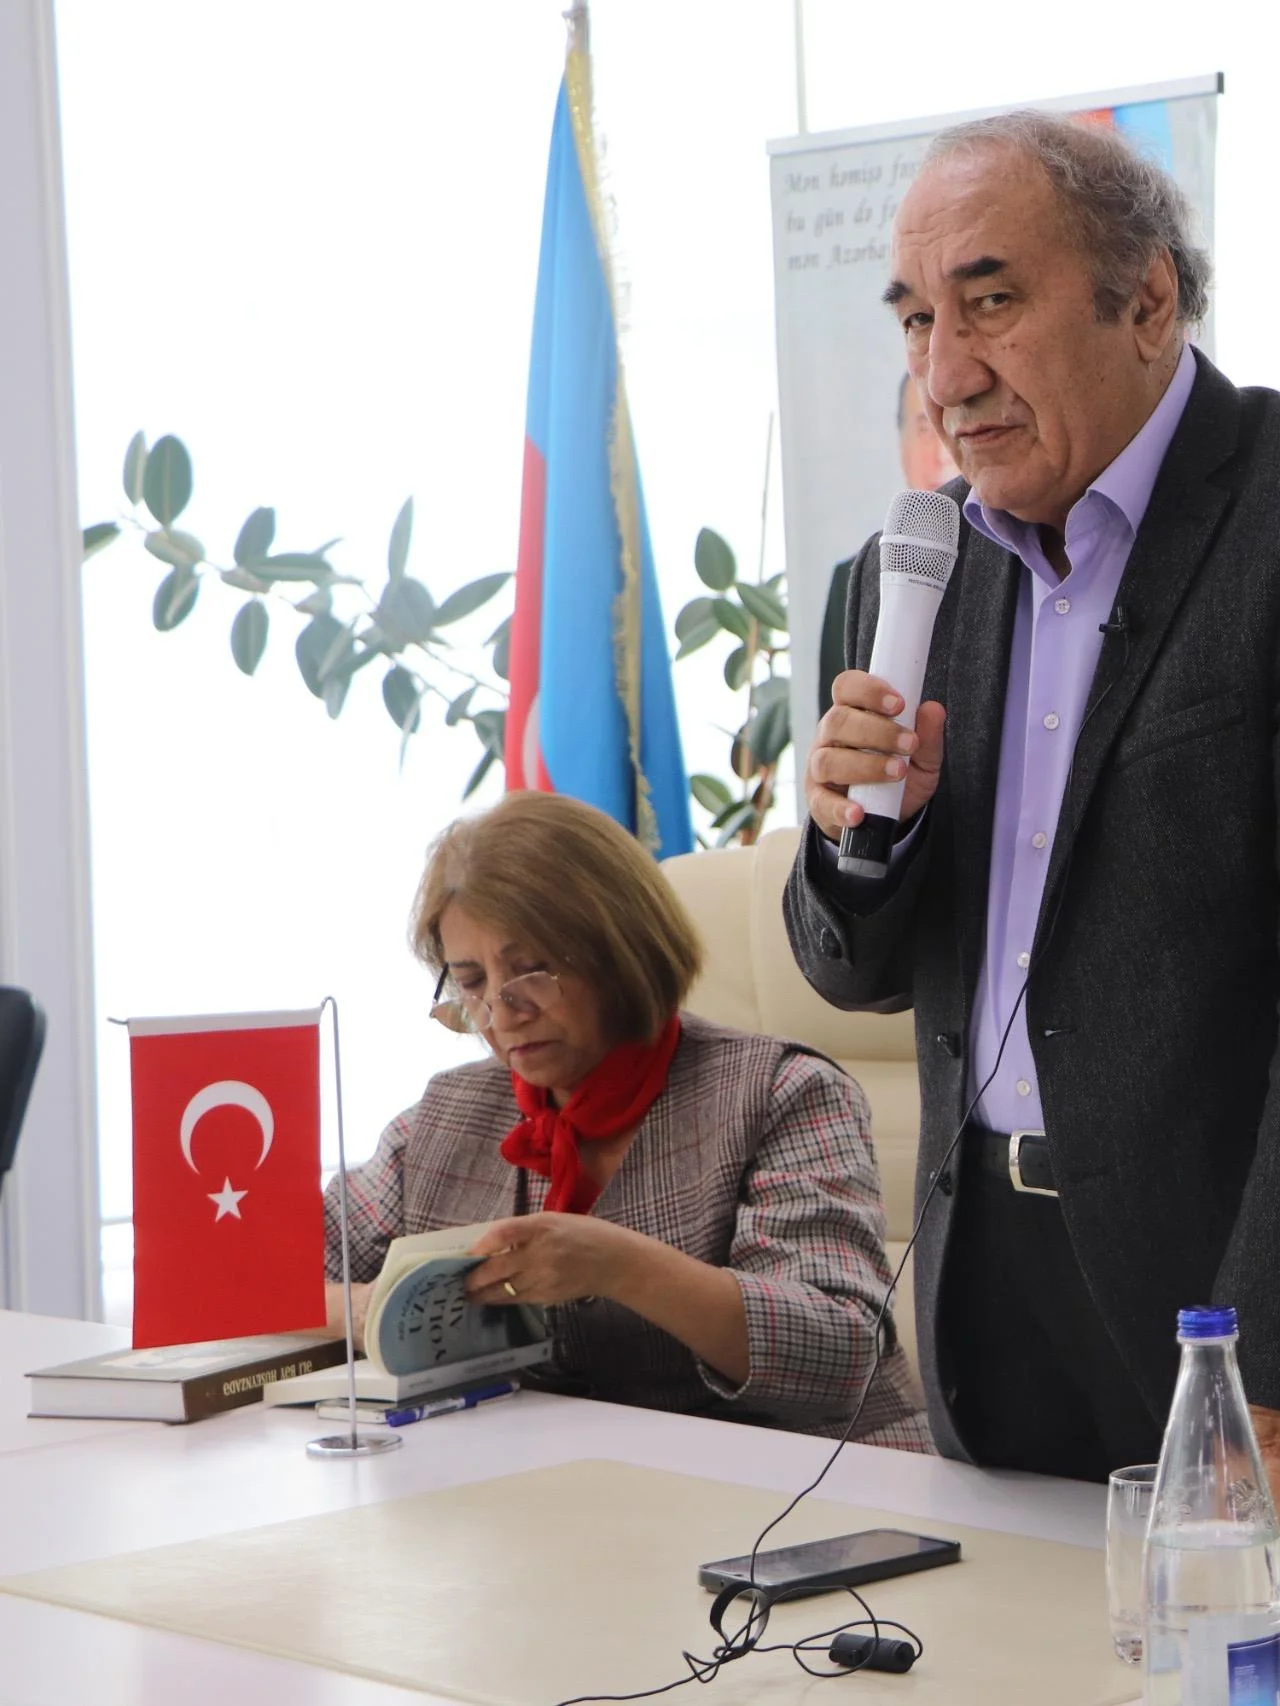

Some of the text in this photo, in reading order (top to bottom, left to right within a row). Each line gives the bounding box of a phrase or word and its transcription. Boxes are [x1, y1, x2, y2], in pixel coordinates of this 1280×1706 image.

[786, 207, 806, 233] bu
[814, 206, 845, 238] gün
[853, 196, 875, 225] də
[787, 252, 820, 272] mən
